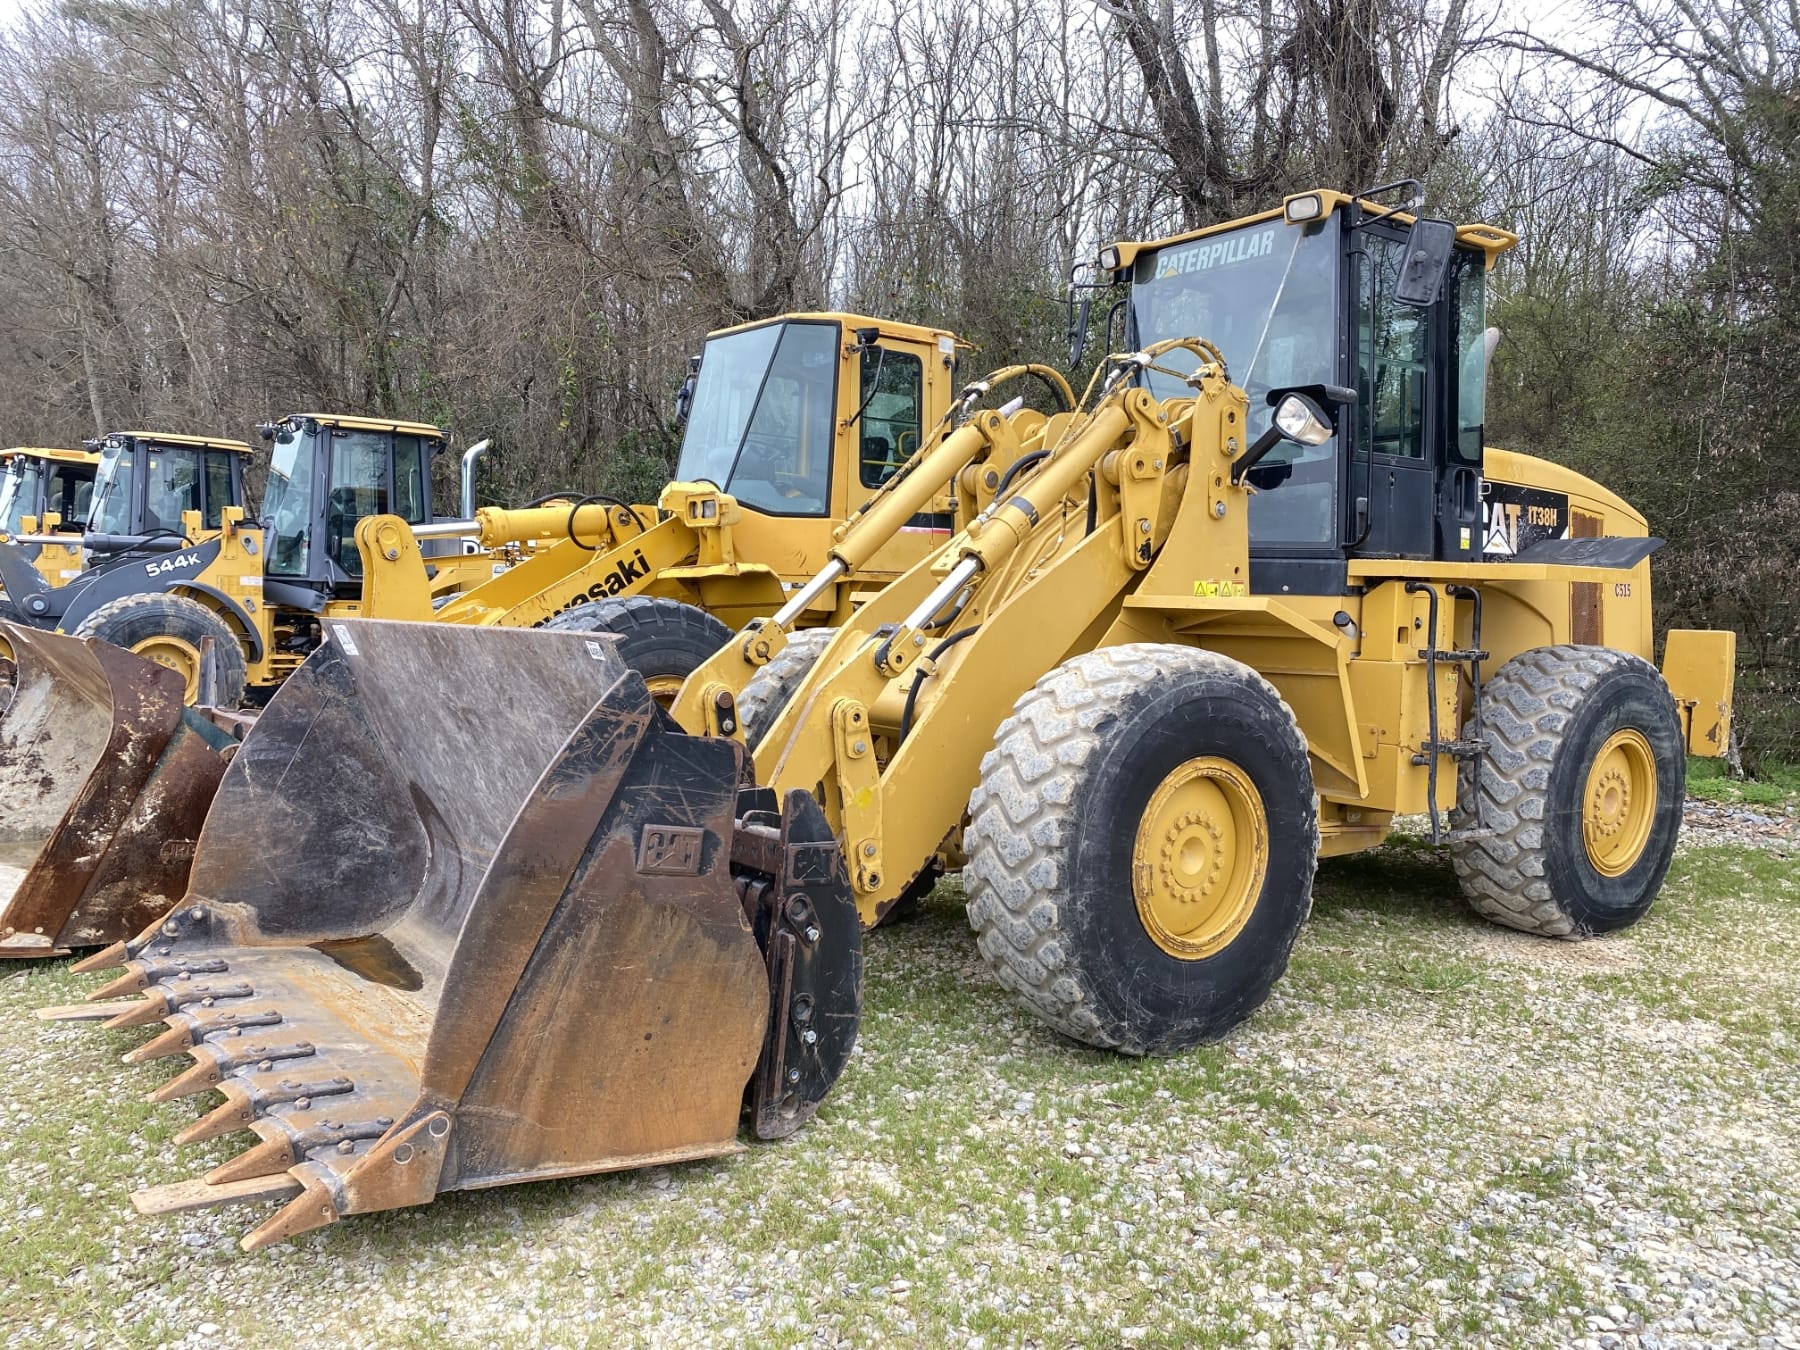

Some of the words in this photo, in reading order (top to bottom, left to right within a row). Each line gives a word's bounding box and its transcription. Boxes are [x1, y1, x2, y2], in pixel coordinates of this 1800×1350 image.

[1155, 229, 1275, 280] CATERPILLAR
[1483, 501, 1522, 555] AT
[1527, 504, 1558, 528] IT38H
[145, 552, 202, 577] 544K
[530, 548, 651, 629] asaki
[1614, 583, 1631, 598] C515
